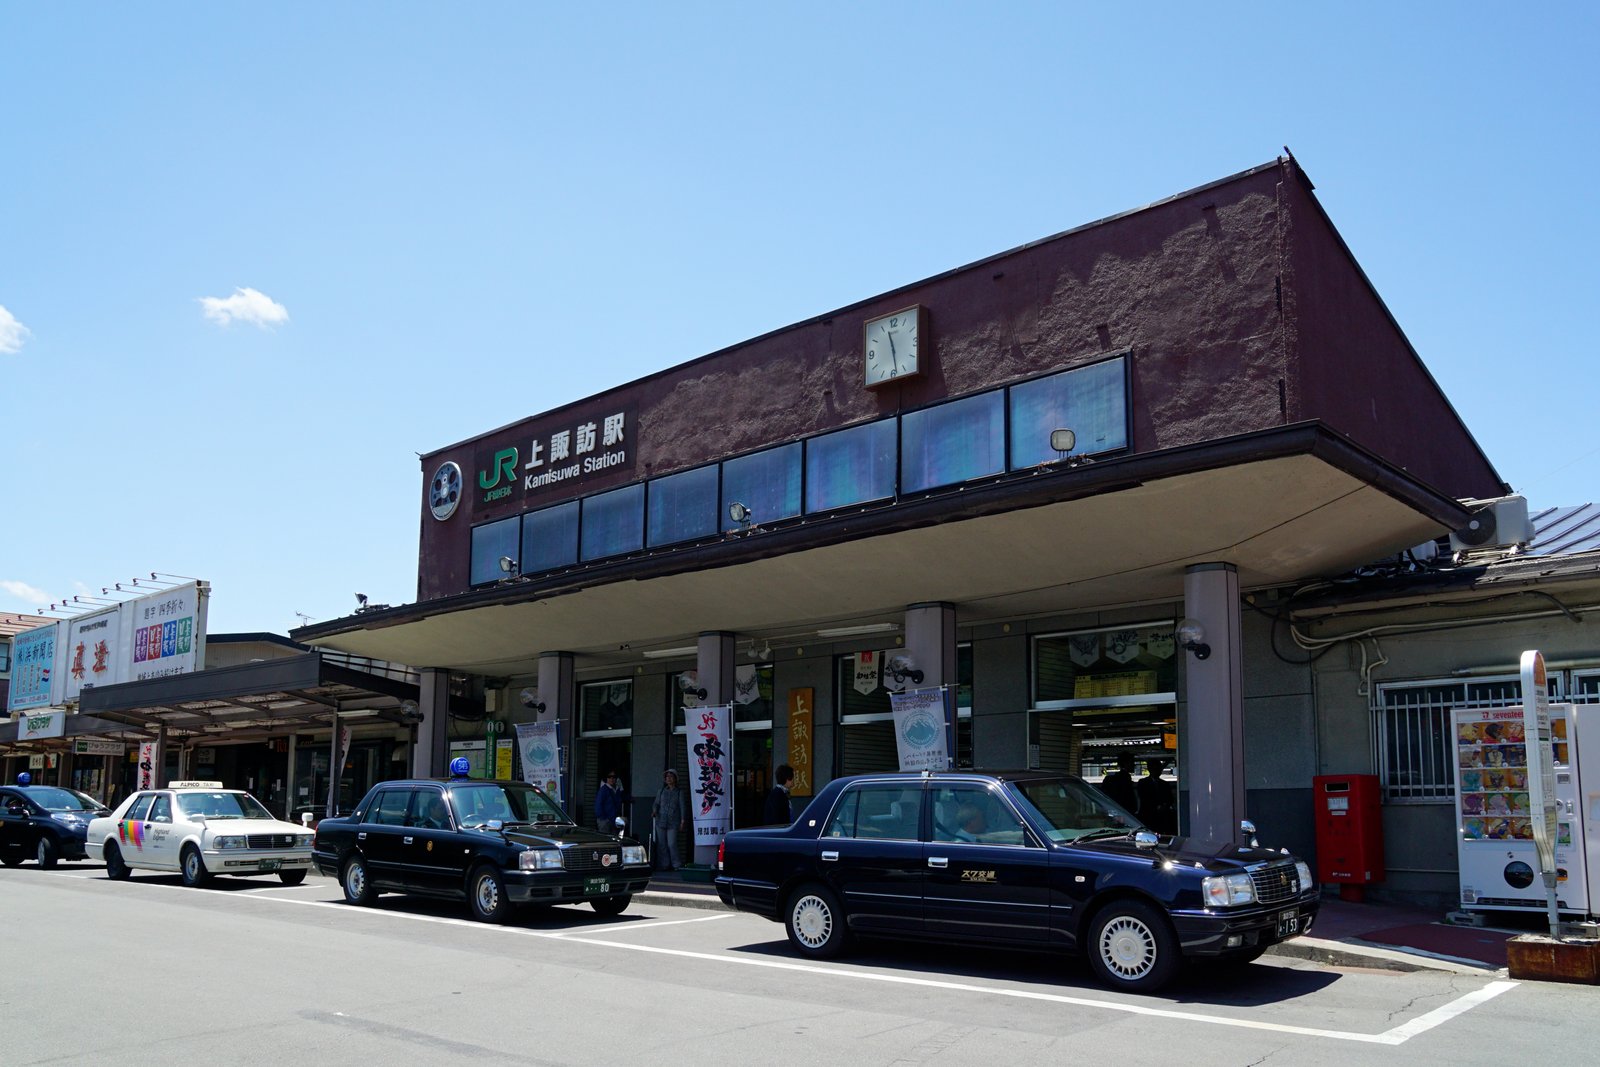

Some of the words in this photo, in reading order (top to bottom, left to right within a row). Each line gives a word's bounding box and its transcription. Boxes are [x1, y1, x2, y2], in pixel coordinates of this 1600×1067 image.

[890, 317, 898, 328] 12
[912, 337, 918, 347] 3
[868, 350, 875, 360] 9
[890, 369, 898, 378] 6
[525, 412, 625, 470] 上諏訪駅
[479, 447, 518, 489] JR
[524, 462, 580, 490] Kamisuwa
[583, 449, 625, 473] Station
[89, 742, 122, 750] びゅうプラザ
[791, 695, 810, 789] 上諏訪駅
